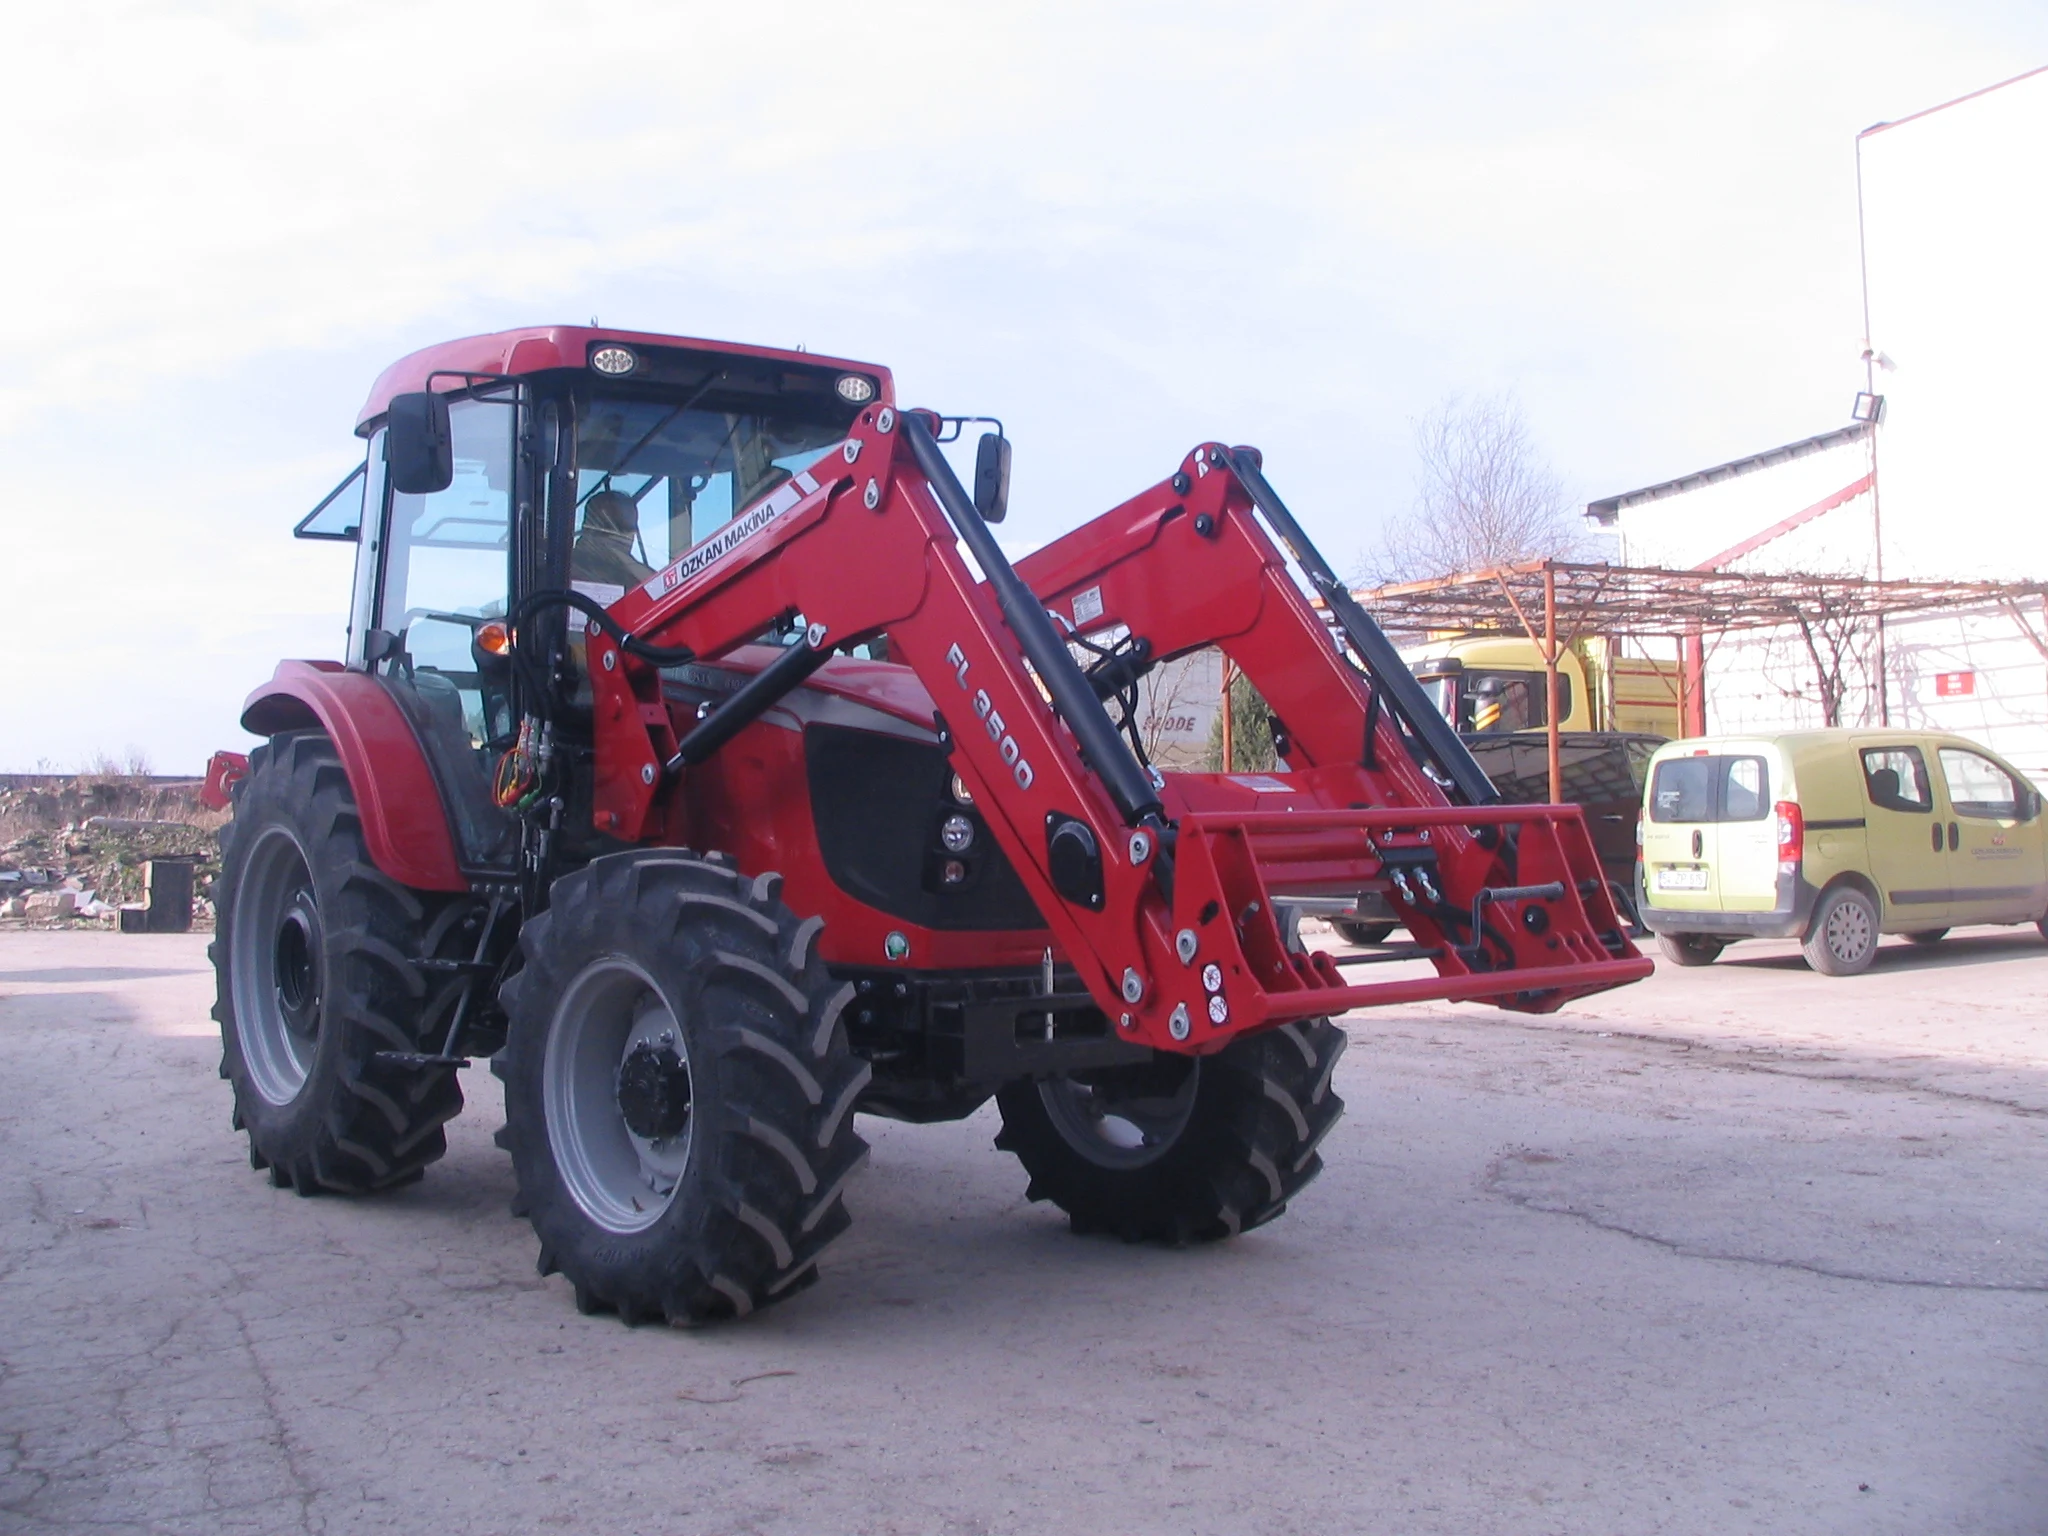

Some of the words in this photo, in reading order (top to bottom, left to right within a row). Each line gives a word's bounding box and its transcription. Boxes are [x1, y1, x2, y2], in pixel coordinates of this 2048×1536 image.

[681, 540, 723, 578] ÖZKAN
[724, 503, 775, 552] MAKİNA
[945, 641, 970, 690] FL
[971, 688, 1034, 791] 3500
